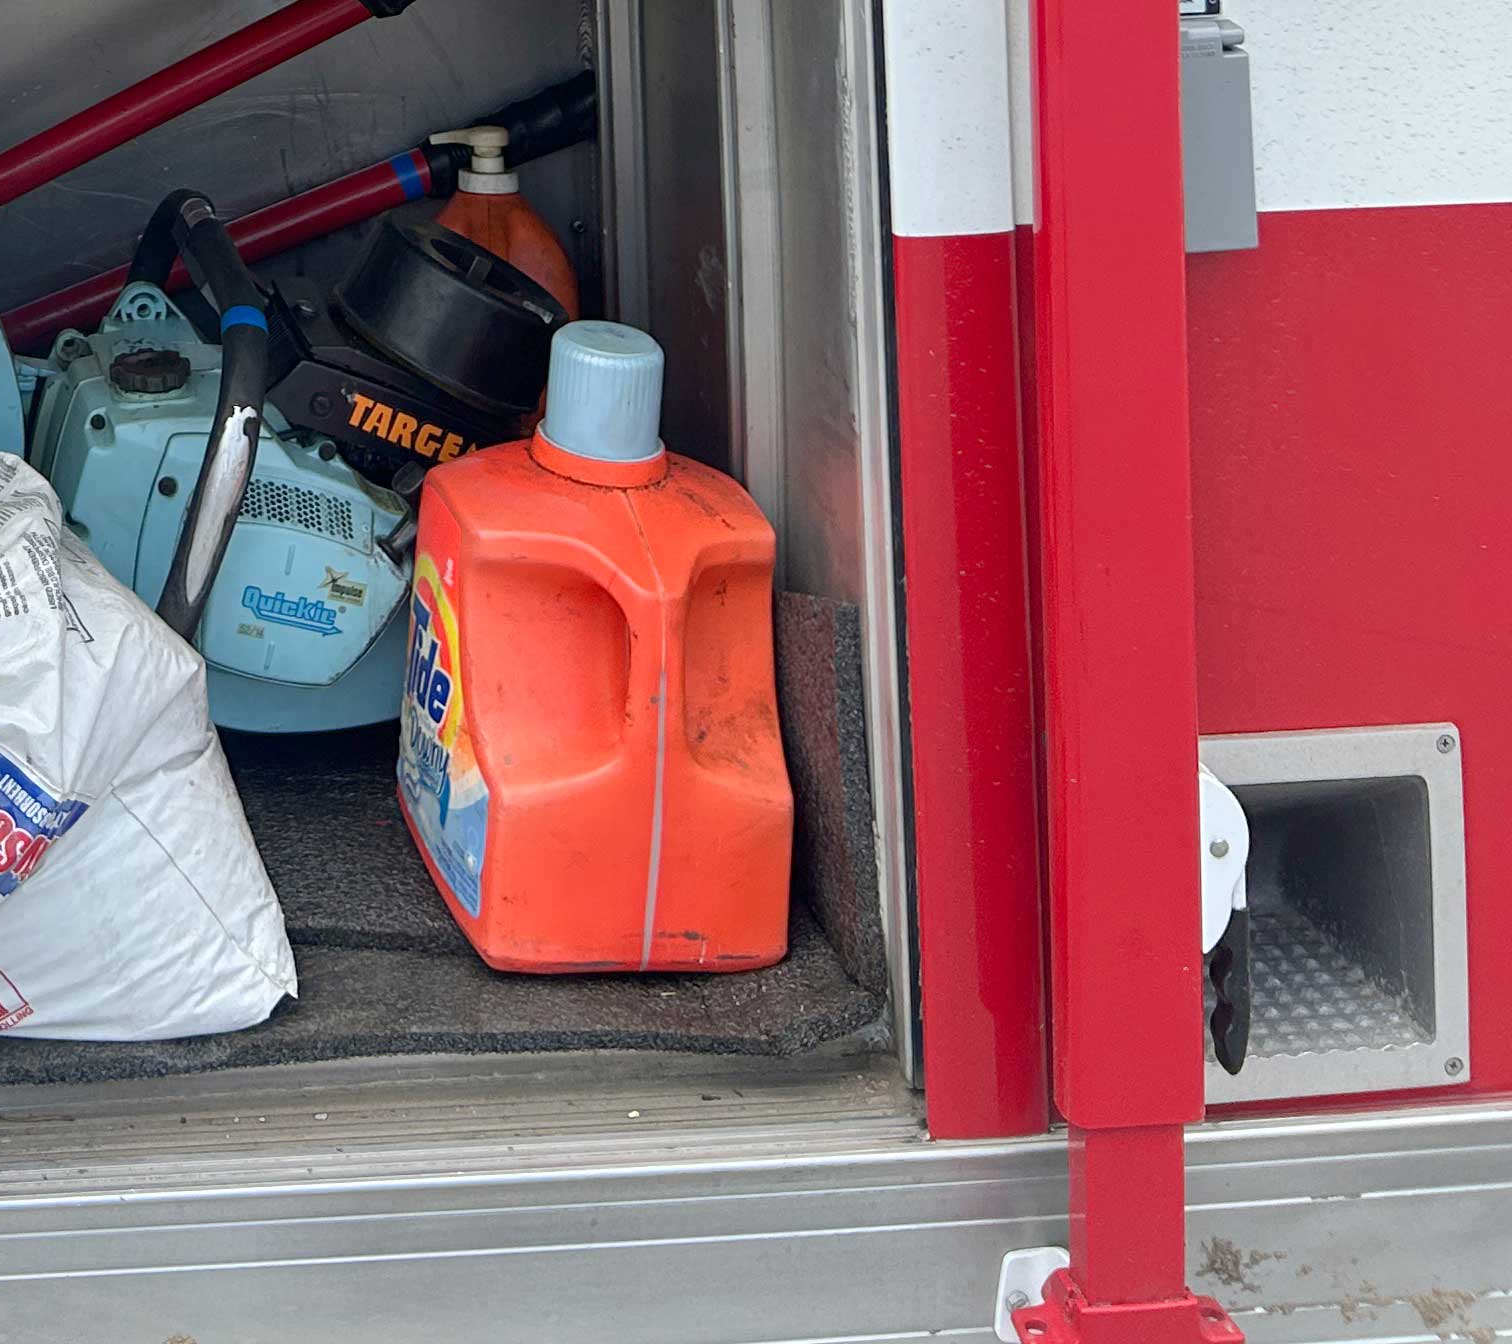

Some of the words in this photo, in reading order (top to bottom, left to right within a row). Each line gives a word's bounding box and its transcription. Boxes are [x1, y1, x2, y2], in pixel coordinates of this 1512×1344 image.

[349, 393, 477, 463] TARGE
[241, 585, 337, 625] Quickie
[407, 591, 453, 725] Tide
